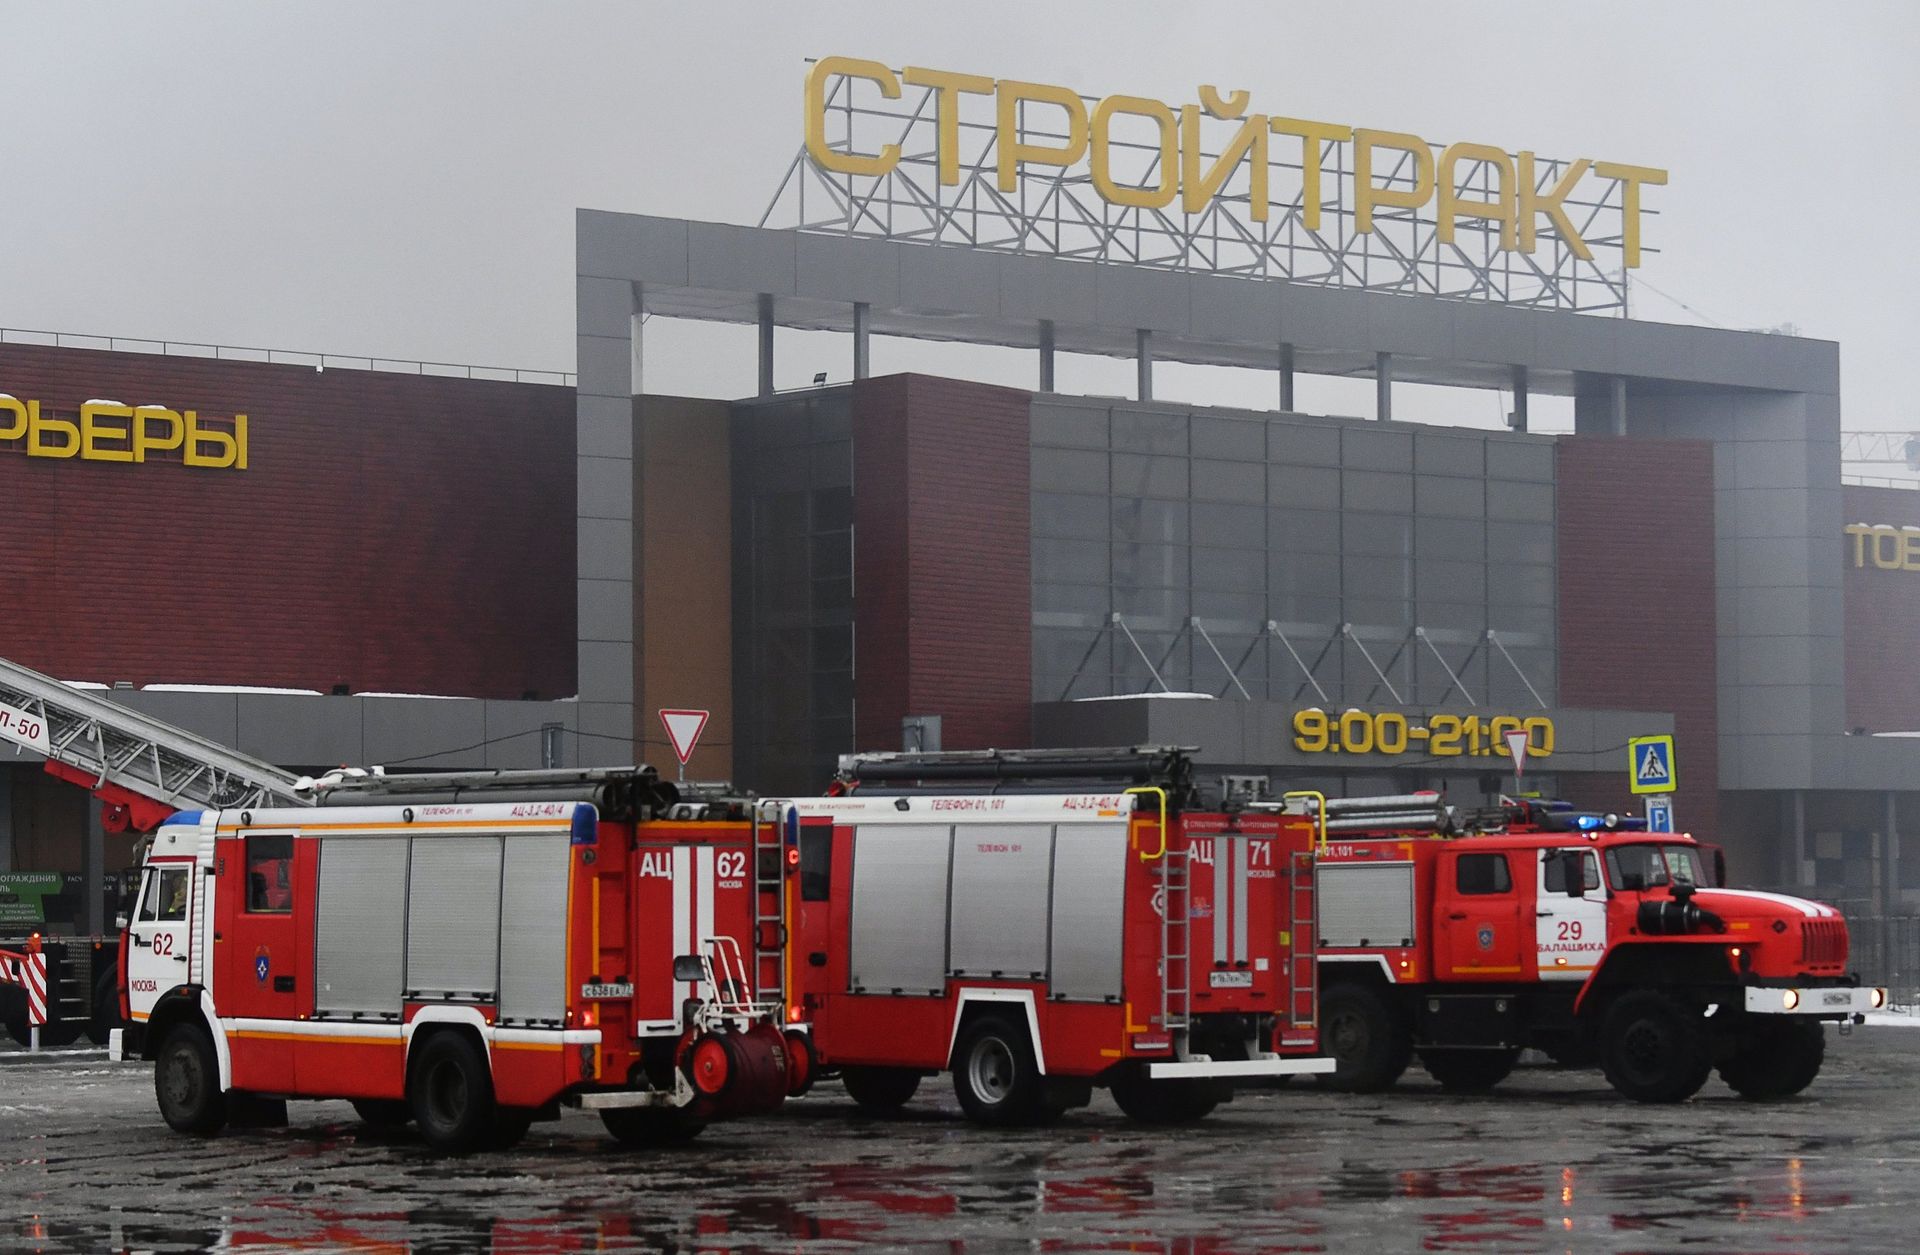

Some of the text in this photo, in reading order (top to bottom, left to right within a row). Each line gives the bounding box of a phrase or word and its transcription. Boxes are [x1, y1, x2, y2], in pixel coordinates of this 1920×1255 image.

[804, 56, 1668, 268] СТРОЙТРАКТ
[1294, 711, 1555, 757] 9:00-21:00
[931, 800, 974, 811] ТЕЛЕФОН
[1187, 840, 1271, 866] АЦ 71
[640, 851, 746, 880] АЦ 62
[1, 875, 57, 883] ОГРАЖДЕНИЯ
[1558, 921, 1582, 941] 29
[153, 933, 173, 956] 62
[1537, 943, 1605, 952] БАЛАШИХА
[131, 980, 157, 992] МОСКВА
